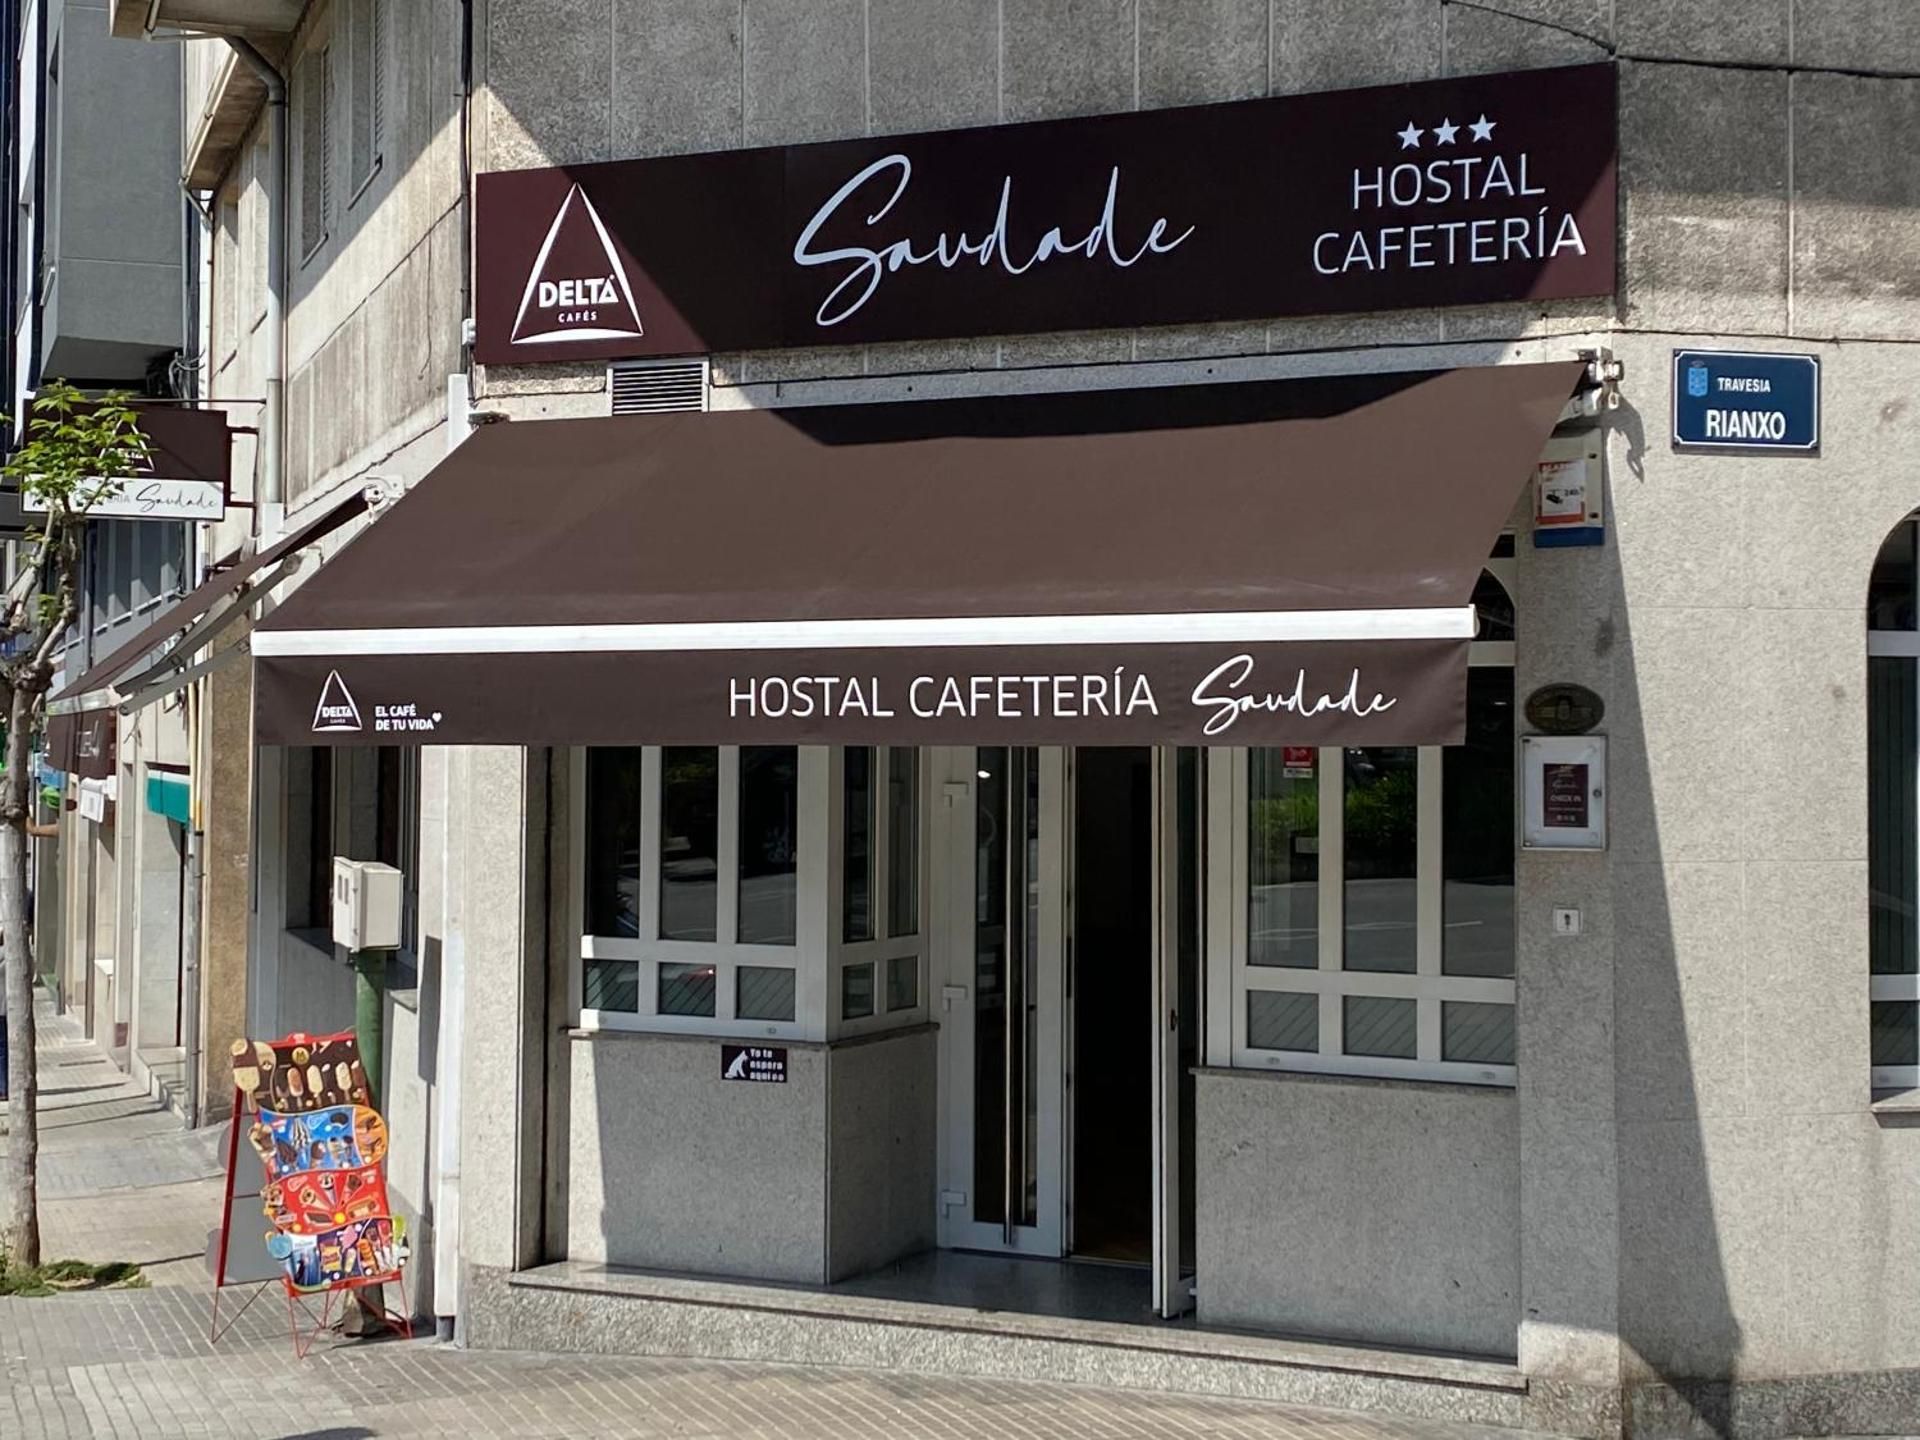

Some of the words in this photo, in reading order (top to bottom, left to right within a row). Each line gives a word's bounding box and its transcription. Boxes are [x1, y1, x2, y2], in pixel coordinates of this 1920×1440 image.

[1353, 152, 1546, 210] HOSTAL
[794, 154, 1195, 326] Saudade
[1313, 207, 1587, 275] CAFETERÍA
[538, 277, 620, 309] DELTA
[558, 310, 598, 323] CAFÉS
[1716, 377, 1771, 392] TRAVESIA
[1705, 409, 1786, 440] RIANXO
[729, 676, 894, 718] HOSTAL
[909, 666, 1158, 717] CAFETERÍA
[1191, 654, 1396, 736] Saudade
[322, 706, 353, 718] DELTA
[375, 706, 389, 717] EL
[389, 703, 417, 717] CAFÉ
[375, 719, 391, 731] DE
[391, 719, 407, 731] TU
[407, 719, 434, 731] VIDA
[750, 1061, 783, 1070] espero
